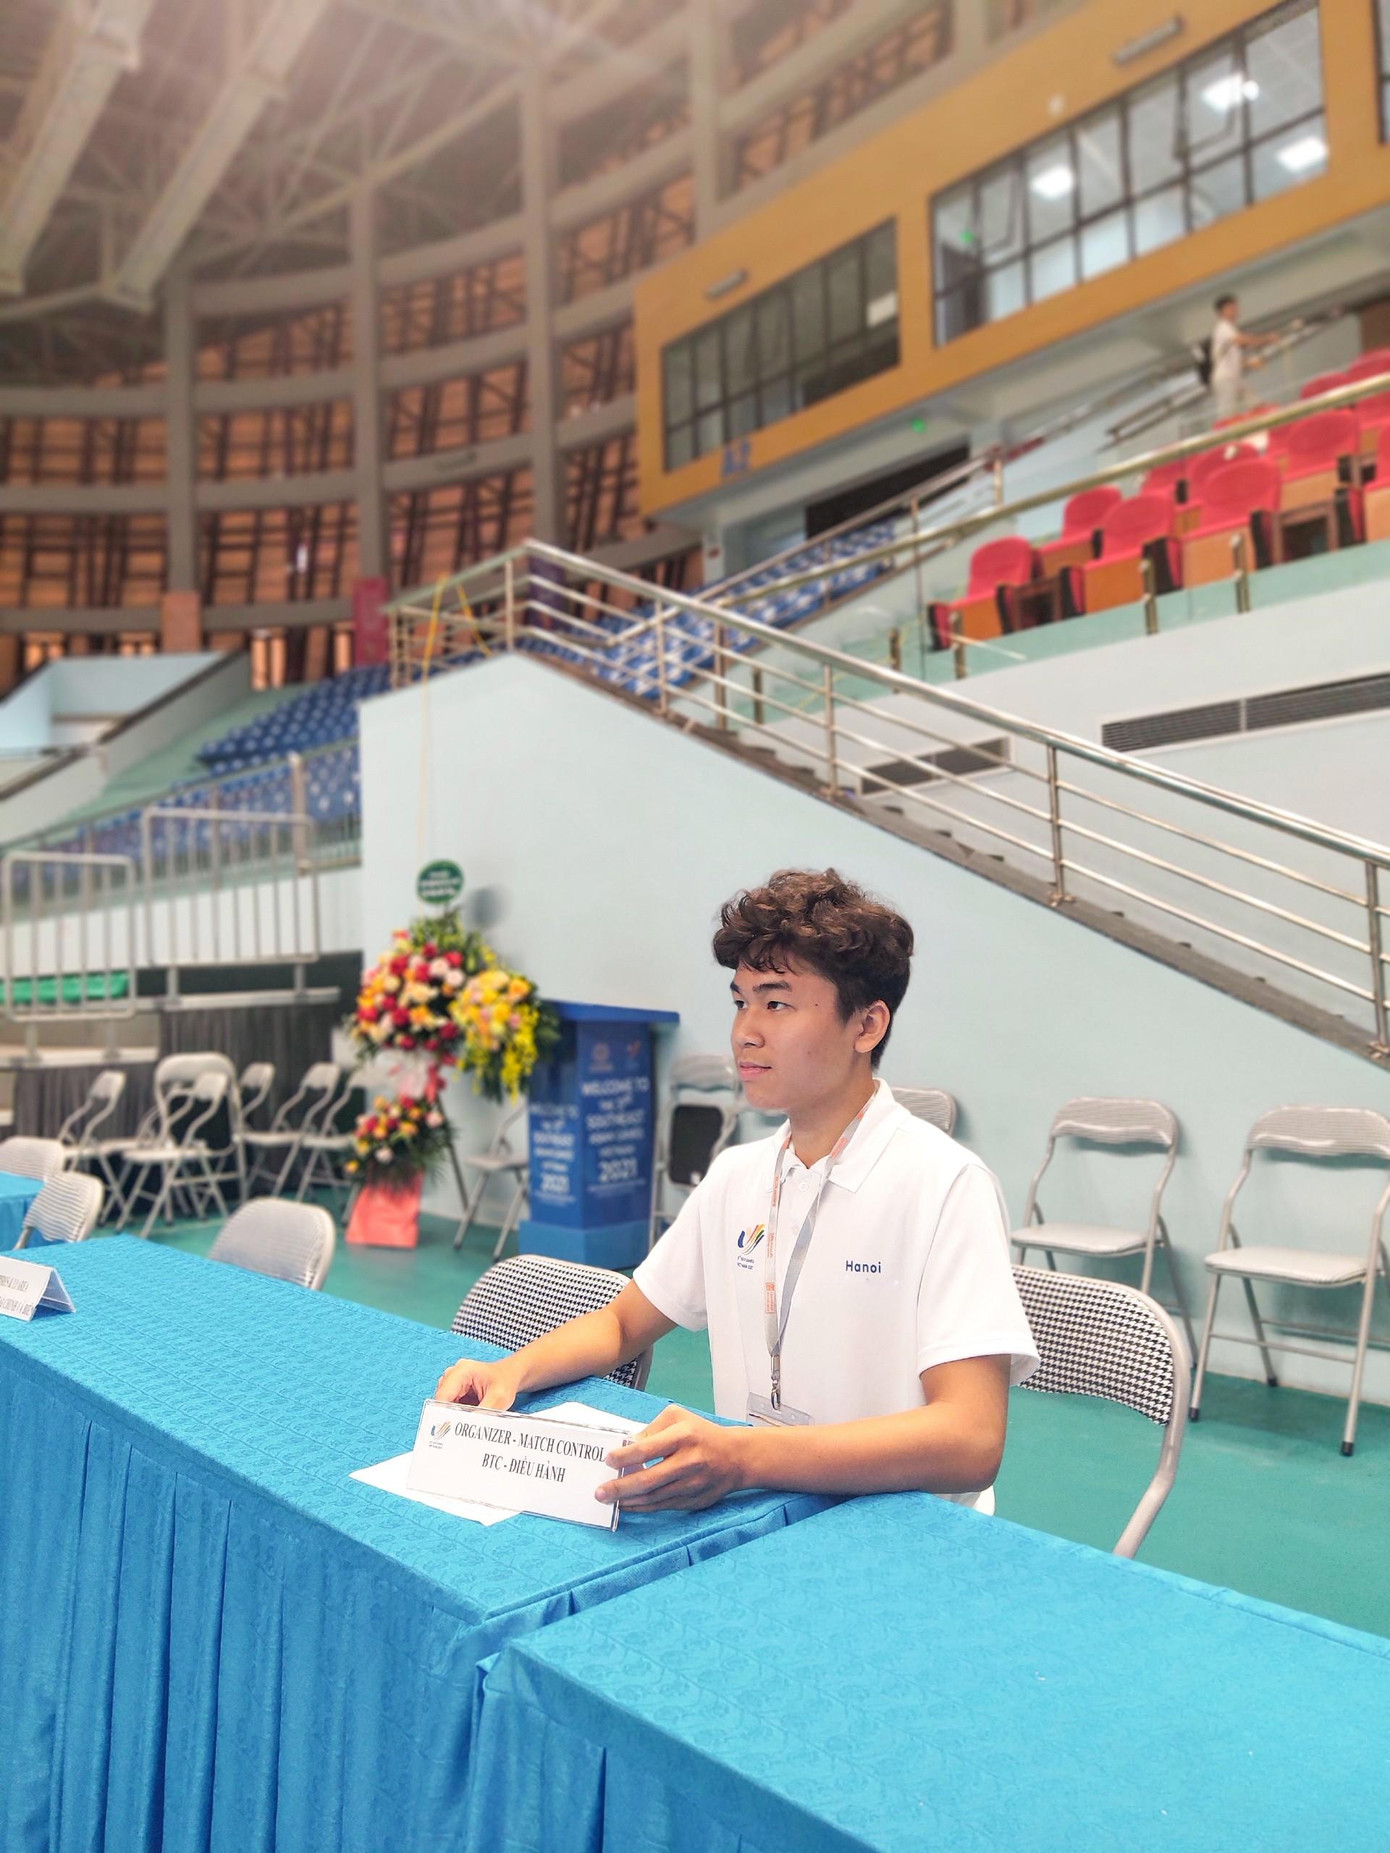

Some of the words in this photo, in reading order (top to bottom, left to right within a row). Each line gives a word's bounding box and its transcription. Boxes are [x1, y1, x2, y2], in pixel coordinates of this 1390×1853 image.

[599, 1157, 638, 1183] 2021
[845, 1260, 881, 1273] Hanoi
[454, 1421, 512, 1445] ORGANIZER
[517, 1432, 554, 1454] MATCH
[556, 1438, 606, 1463] CONTROL
[481, 1453, 502, 1471] BTC
[535, 1459, 567, 1483] HÀNH
